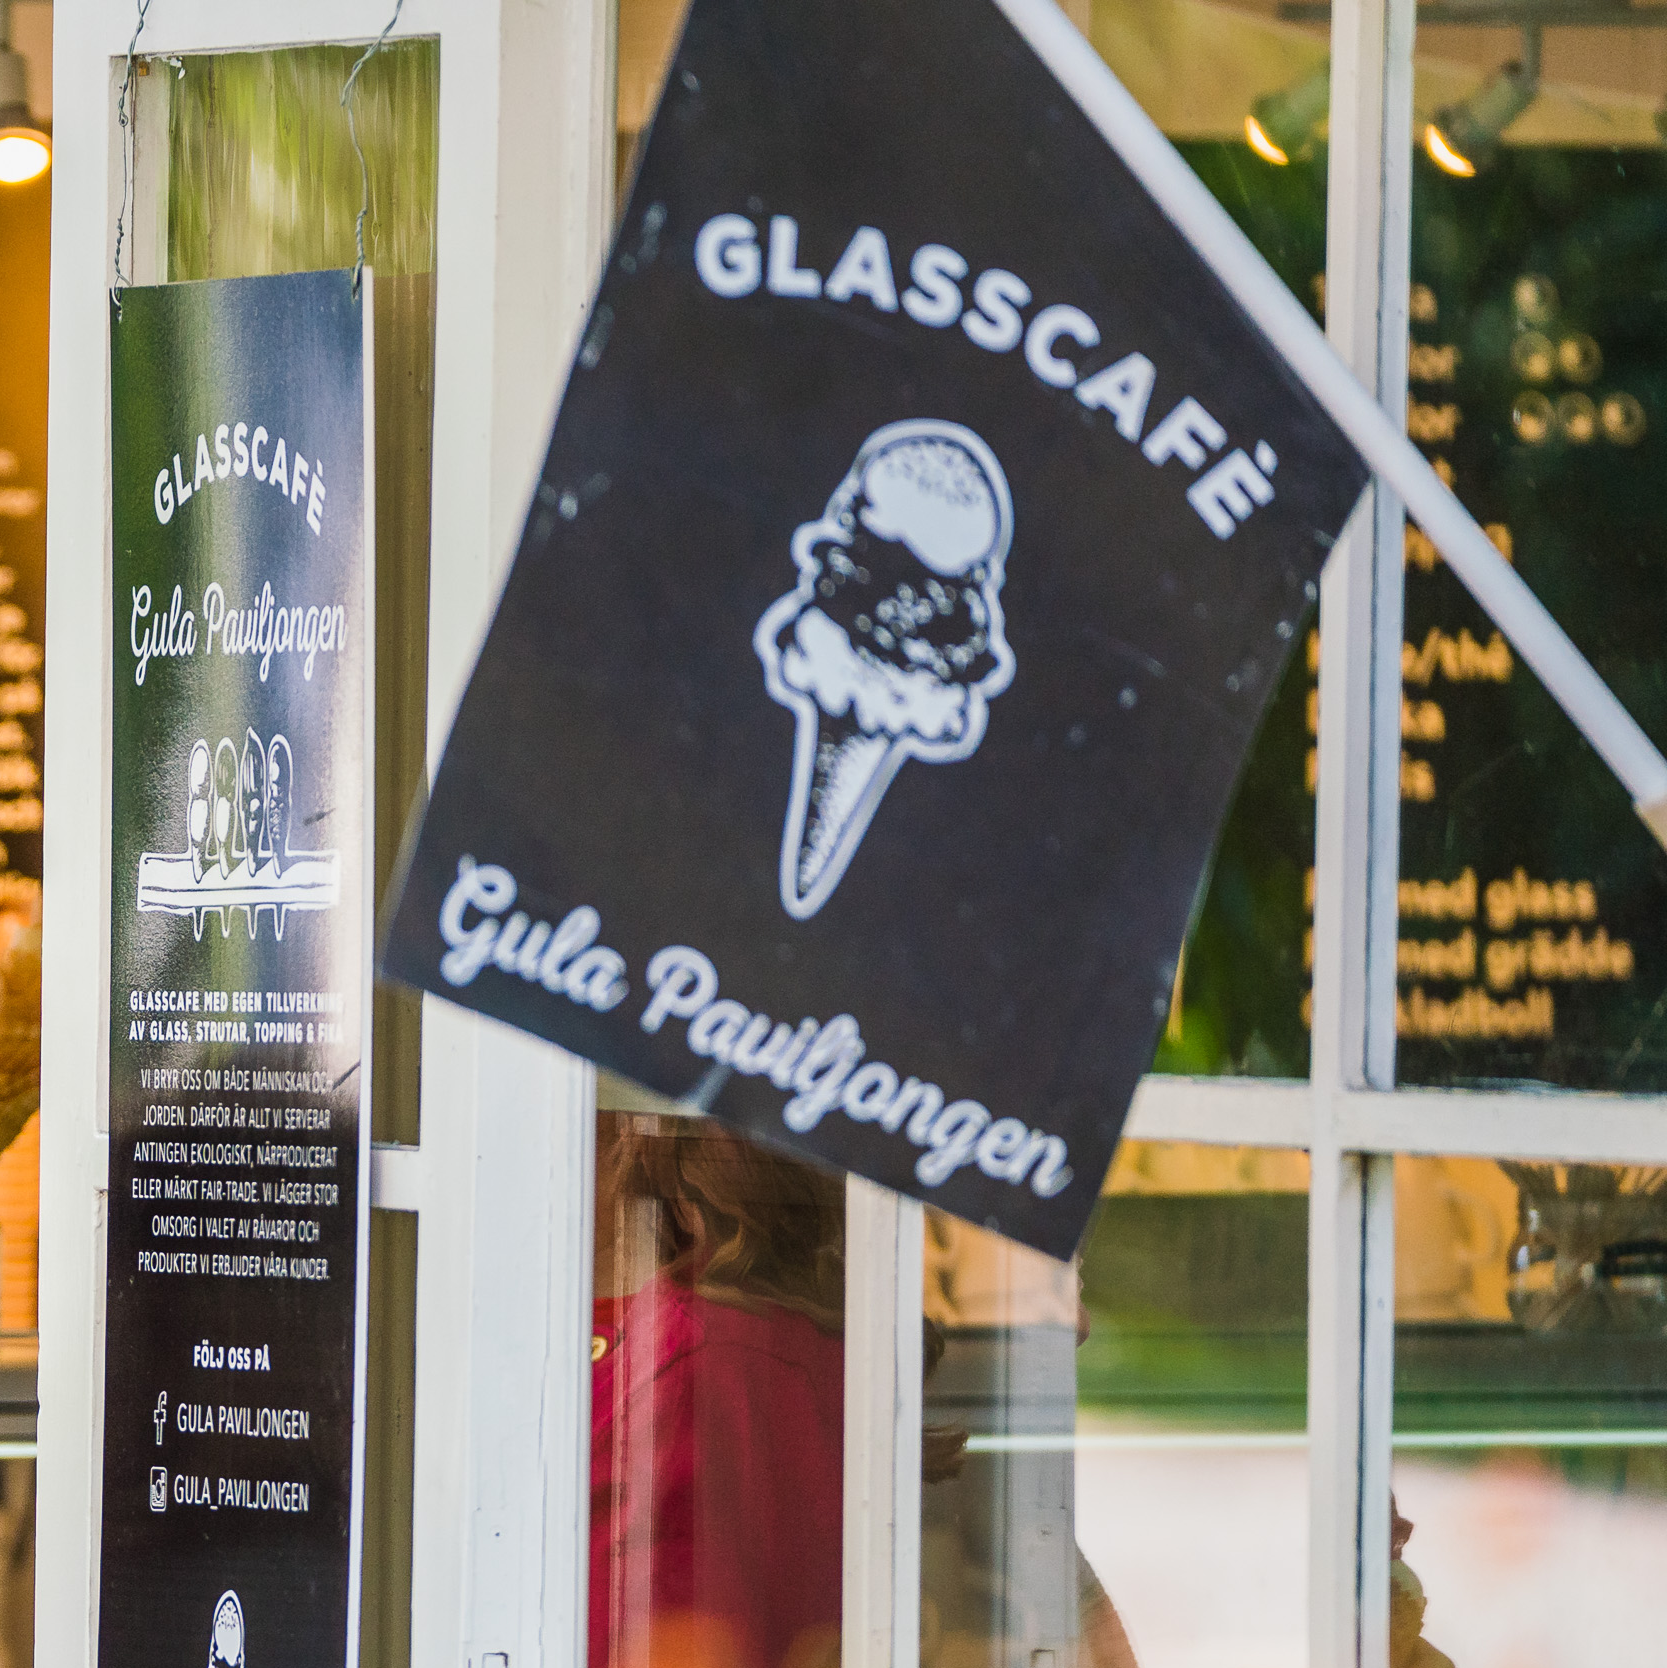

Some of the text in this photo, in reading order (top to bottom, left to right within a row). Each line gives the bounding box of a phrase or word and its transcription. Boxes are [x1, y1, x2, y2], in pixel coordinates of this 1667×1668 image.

[131, 580, 347, 686] Gula Paviljongen
[130, 991, 200, 1012] GLASSCAFE
[204, 991, 229, 1012] MED
[232, 991, 262, 1013] EGEN
[129, 1020, 145, 1041] AV
[150, 1020, 192, 1044] GLASS,
[196, 1021, 251, 1045] STRUTAR,
[254, 1022, 303, 1044] TOPPING
[440, 854, 1072, 1197] Gula Paviljongen
[141, 1068, 151, 1089] VI
[154, 1068, 179, 1090] BRYR
[181, 1069, 201, 1091] OSS
[204, 1069, 221, 1091] OM
[224, 1064, 250, 1092] BÅDE
[253, 1066, 310, 1093] MÄNNISKAN
[143, 1102, 331, 1130] JORDEN. DÄRFÖR ÄR ALLT VI SERVERAR
[134, 1141, 338, 1168] ANTINGEN EKOLOGISKT, NÄRPRODUCERAT
[132, 1175, 340, 1206] ELLER MÄRKT FAIR-TRADE. VI LÄGGER STOR
[152, 1213, 321, 1242] OMSORG I VALET AV RÅVAROR OCH
[138, 1251, 331, 1280] PRODUKTER VI ERBJUDER VÅRA KUNDER.
[193, 1339, 271, 1371] FÖLJ OSS PÅ
[177, 1402, 214, 1433] GULA
[218, 1405, 310, 1440] PAVILJONGEN
[174, 1474, 309, 1513] GULA_PAVILJONGEN
